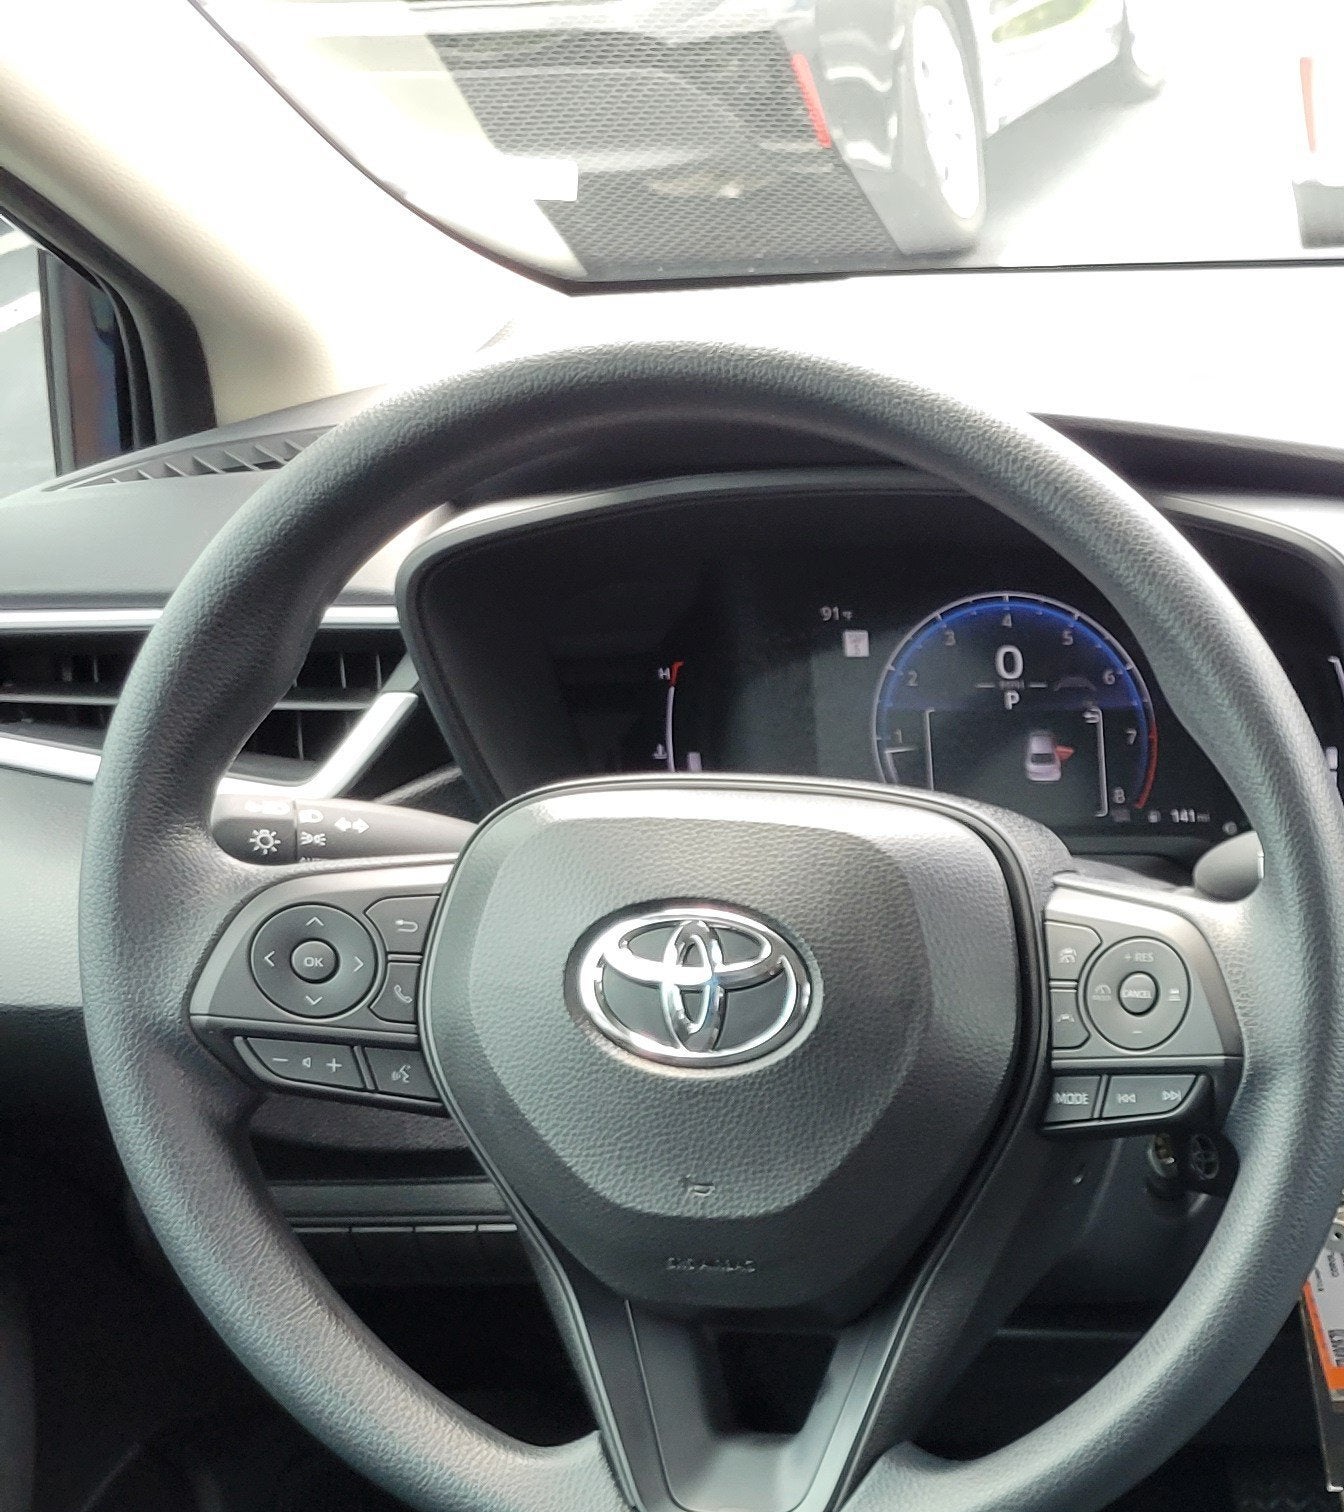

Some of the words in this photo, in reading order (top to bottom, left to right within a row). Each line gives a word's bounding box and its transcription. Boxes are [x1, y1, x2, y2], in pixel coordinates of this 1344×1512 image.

[1003, 614, 1013, 628] 4
[947, 630, 957, 646] 3
[1062, 630, 1074, 646] 5
[994, 644, 1024, 681] 0
[907, 671, 918, 688] 2
[1103, 671, 1116, 686] 6
[1003, 690, 1021, 711] P
[1126, 728, 1138, 746] 7
[1111, 786, 1126, 804] 8
[303, 956, 324, 968] OK
[1134, 951, 1154, 963] RES
[1121, 989, 1152, 998] CANCEL
[1054, 1091, 1090, 1105] MODE
